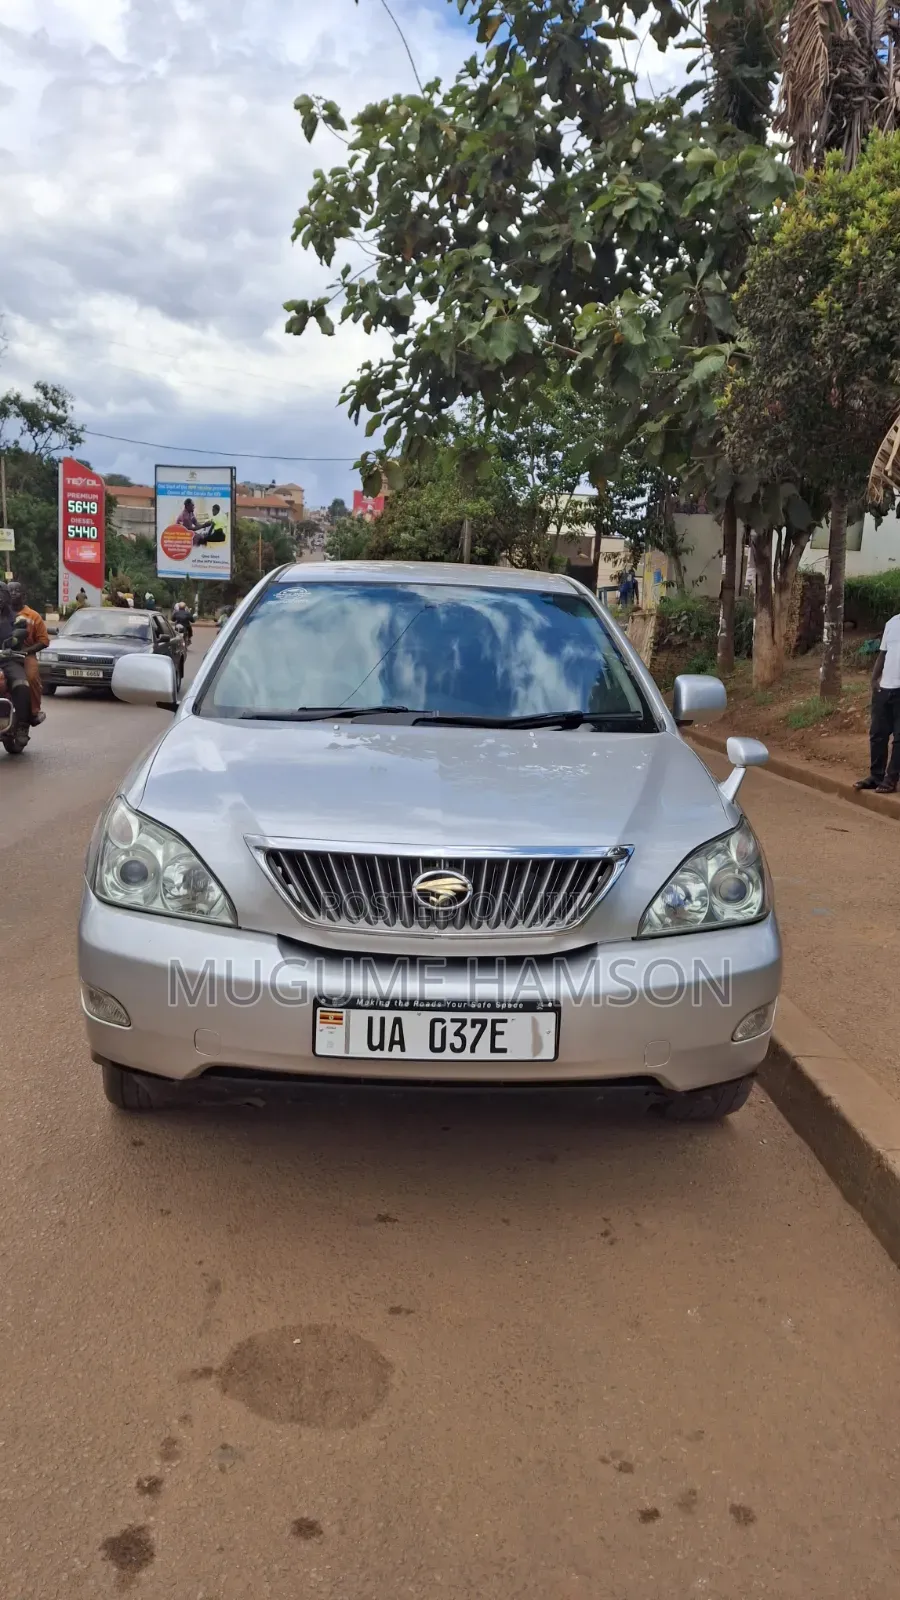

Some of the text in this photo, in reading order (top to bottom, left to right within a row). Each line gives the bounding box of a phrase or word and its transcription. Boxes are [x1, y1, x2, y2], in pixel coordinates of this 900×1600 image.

[68, 500, 98, 514] 5649
[71, 517, 94, 525] DIESEL
[68, 525, 98, 539] 5440
[356, 998, 390, 1008] Making
[471, 1001, 491, 1009] Safe
[367, 1016, 509, 1054] UA 037E
